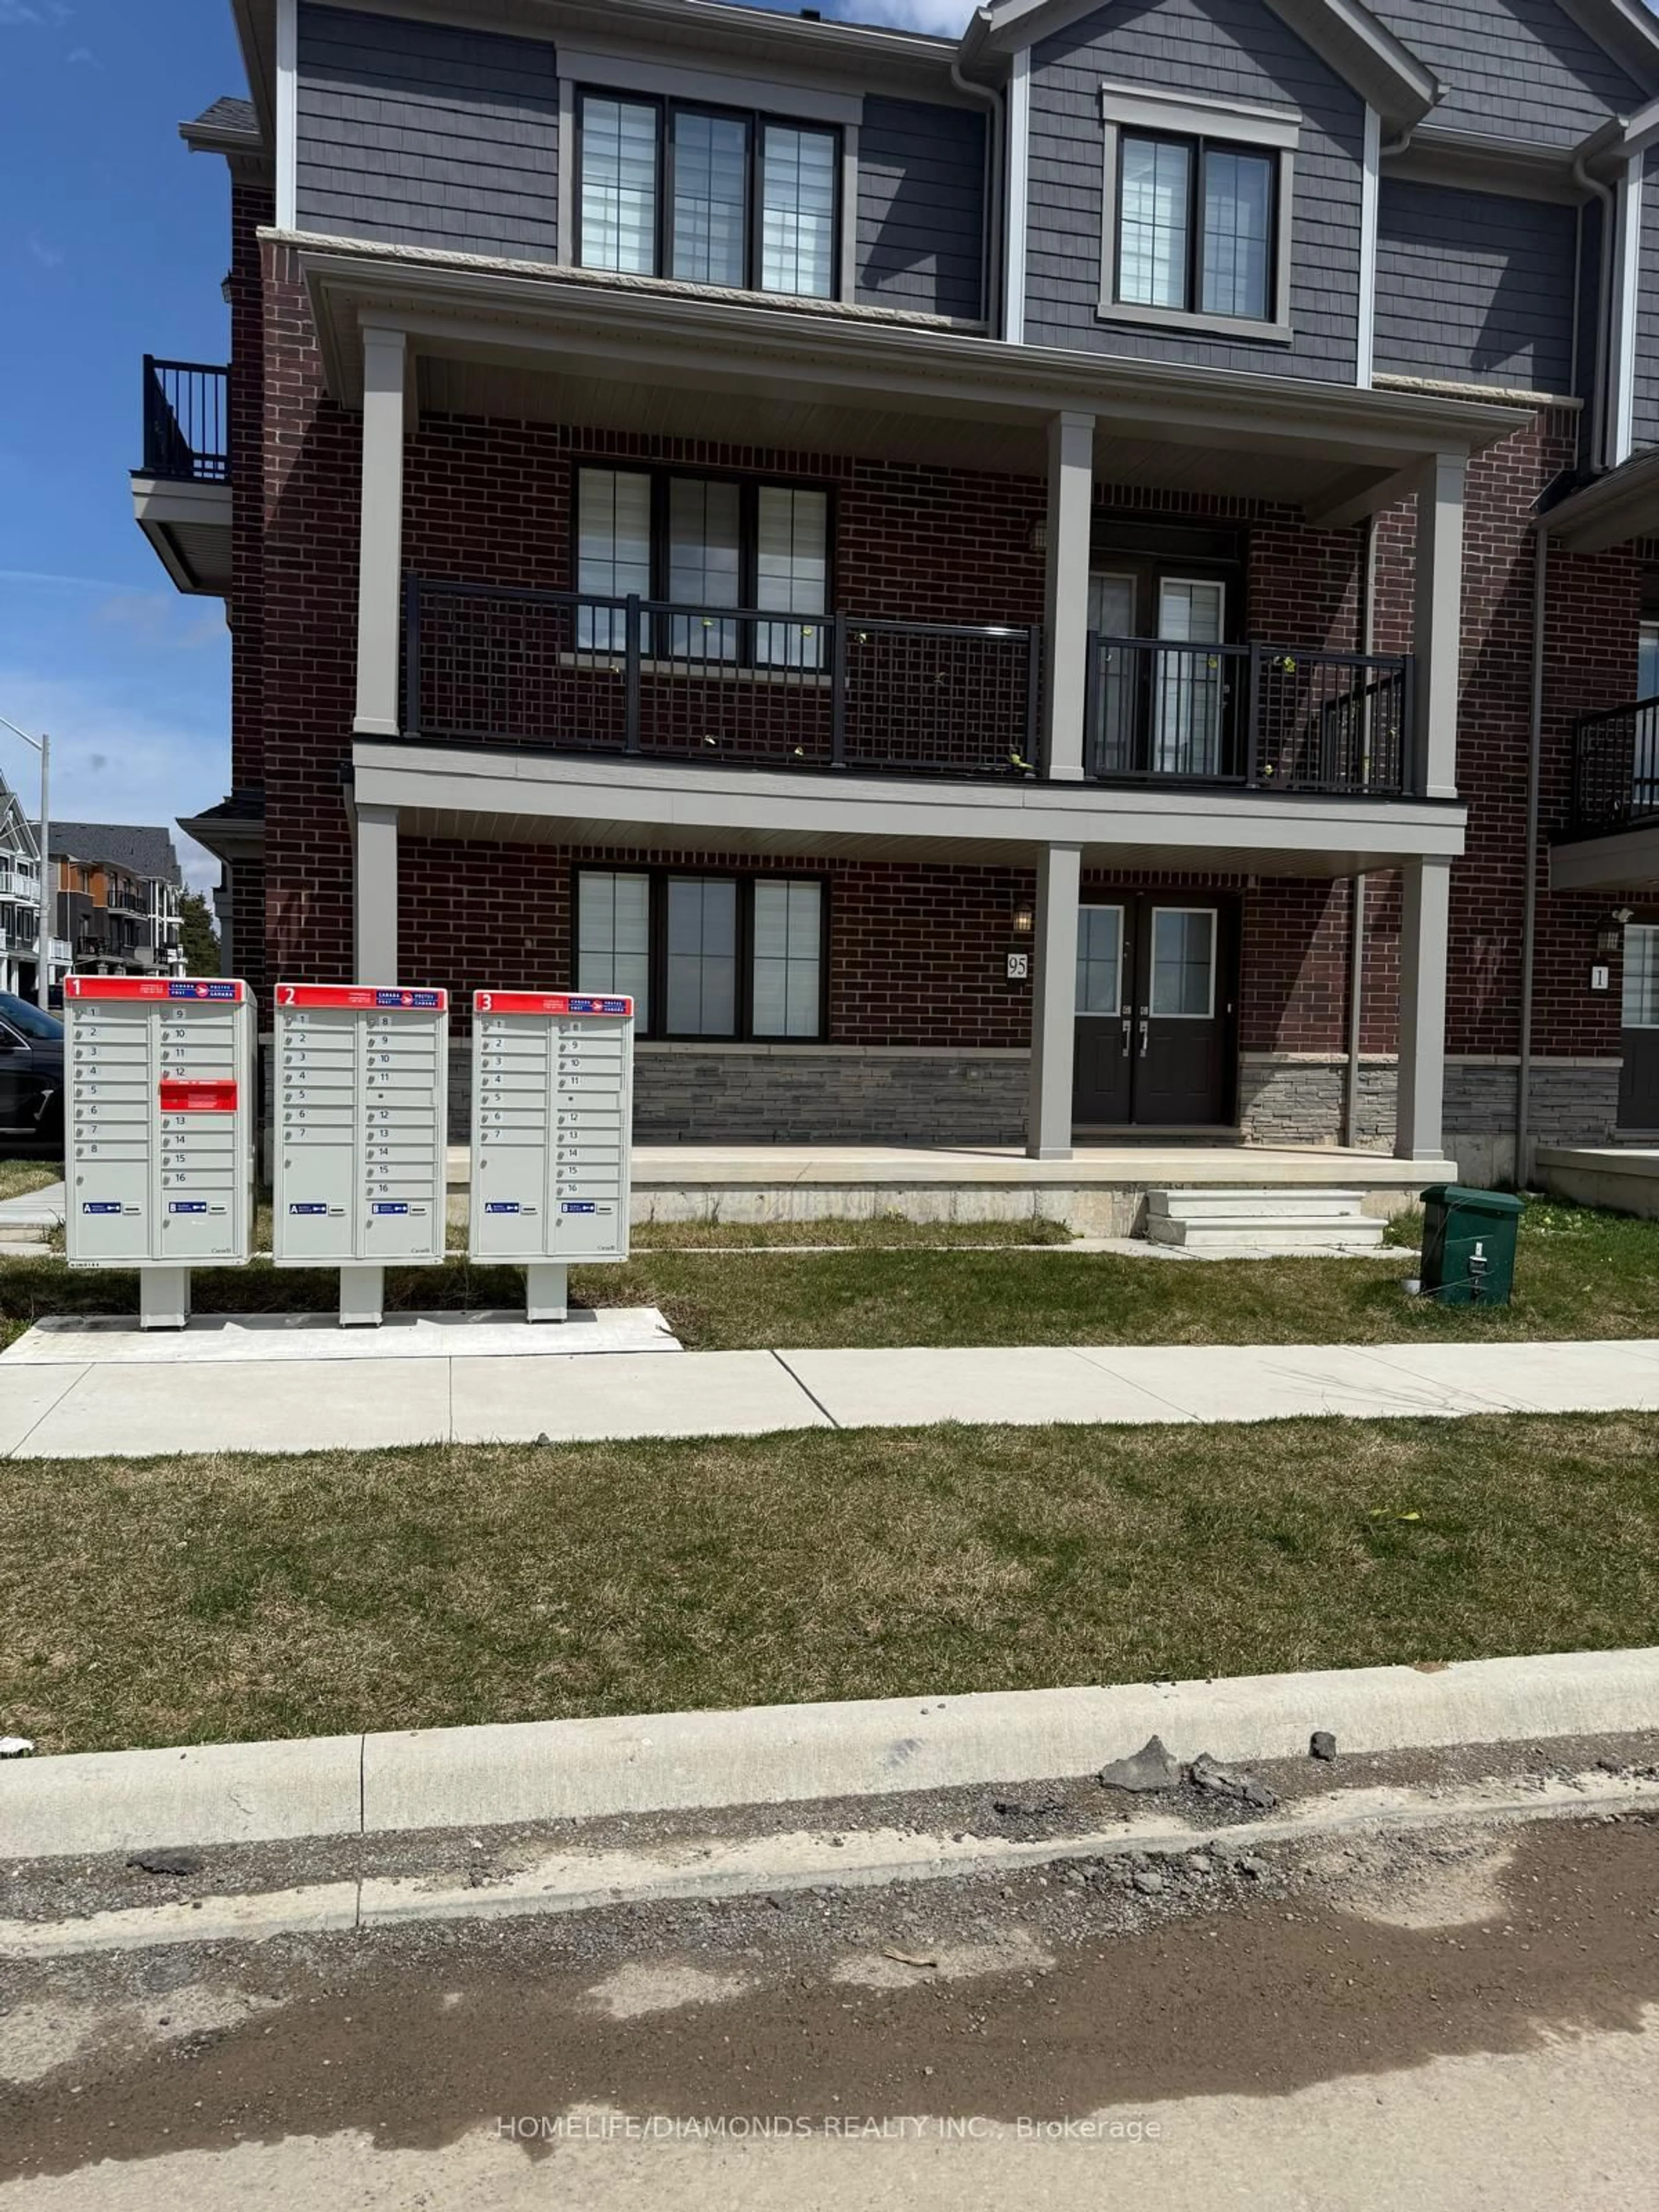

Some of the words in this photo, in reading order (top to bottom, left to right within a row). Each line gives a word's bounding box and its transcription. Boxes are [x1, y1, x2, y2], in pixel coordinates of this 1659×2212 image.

[1009, 957, 1027, 975] 95
[1597, 970, 1603, 986] 1
[73, 979, 80, 995] 1
[284, 988, 296, 1004] 2
[482, 994, 492, 1010] 3
[175, 1030, 185, 1038] 10
[175, 1068, 184, 1076] 12
[91, 1086, 96, 1094] 5
[91, 1106, 97, 1114] 6
